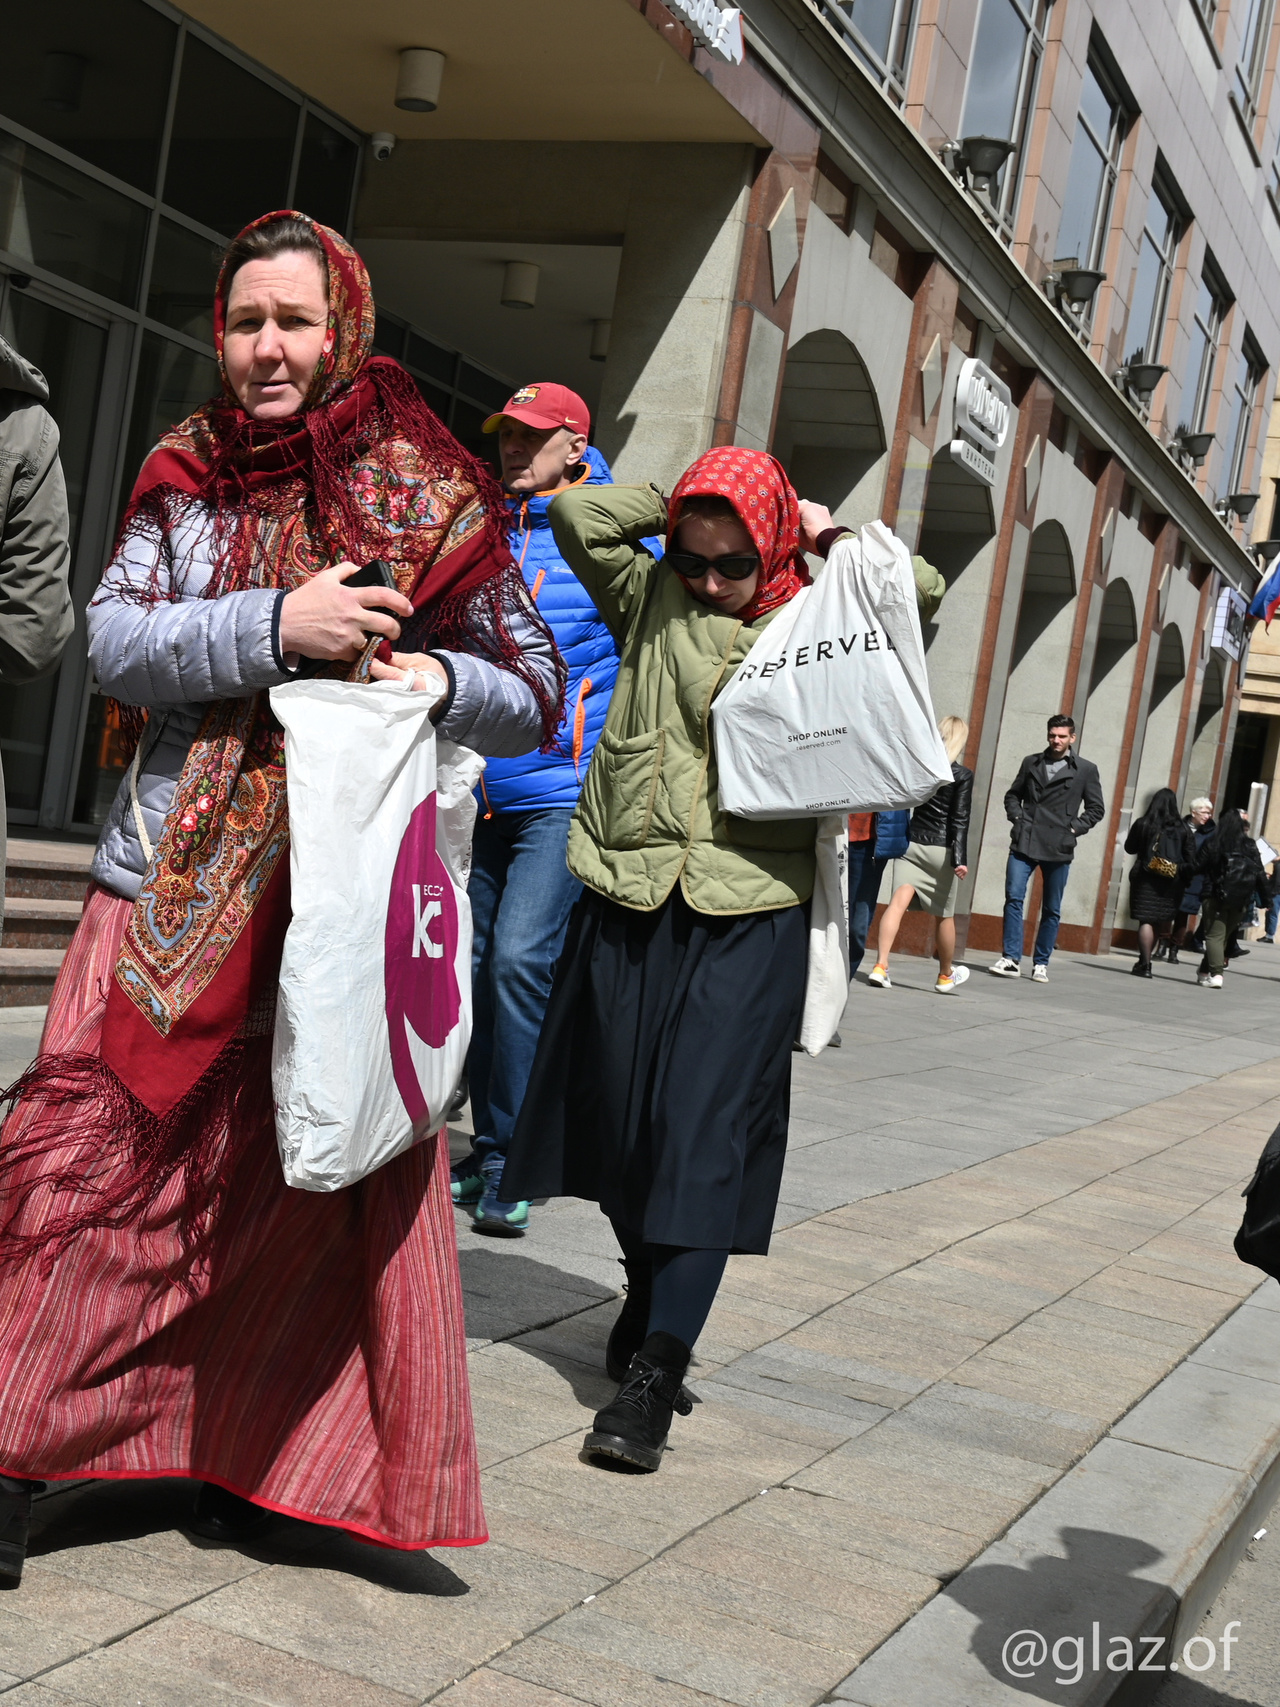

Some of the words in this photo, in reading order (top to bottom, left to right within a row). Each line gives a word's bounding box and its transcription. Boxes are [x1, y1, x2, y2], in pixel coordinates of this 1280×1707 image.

[787, 732, 811, 743] SHOP
[812, 726, 848, 738] ONLINE
[805, 802, 824, 810] SHOP
[825, 798, 851, 807] ONLINE
